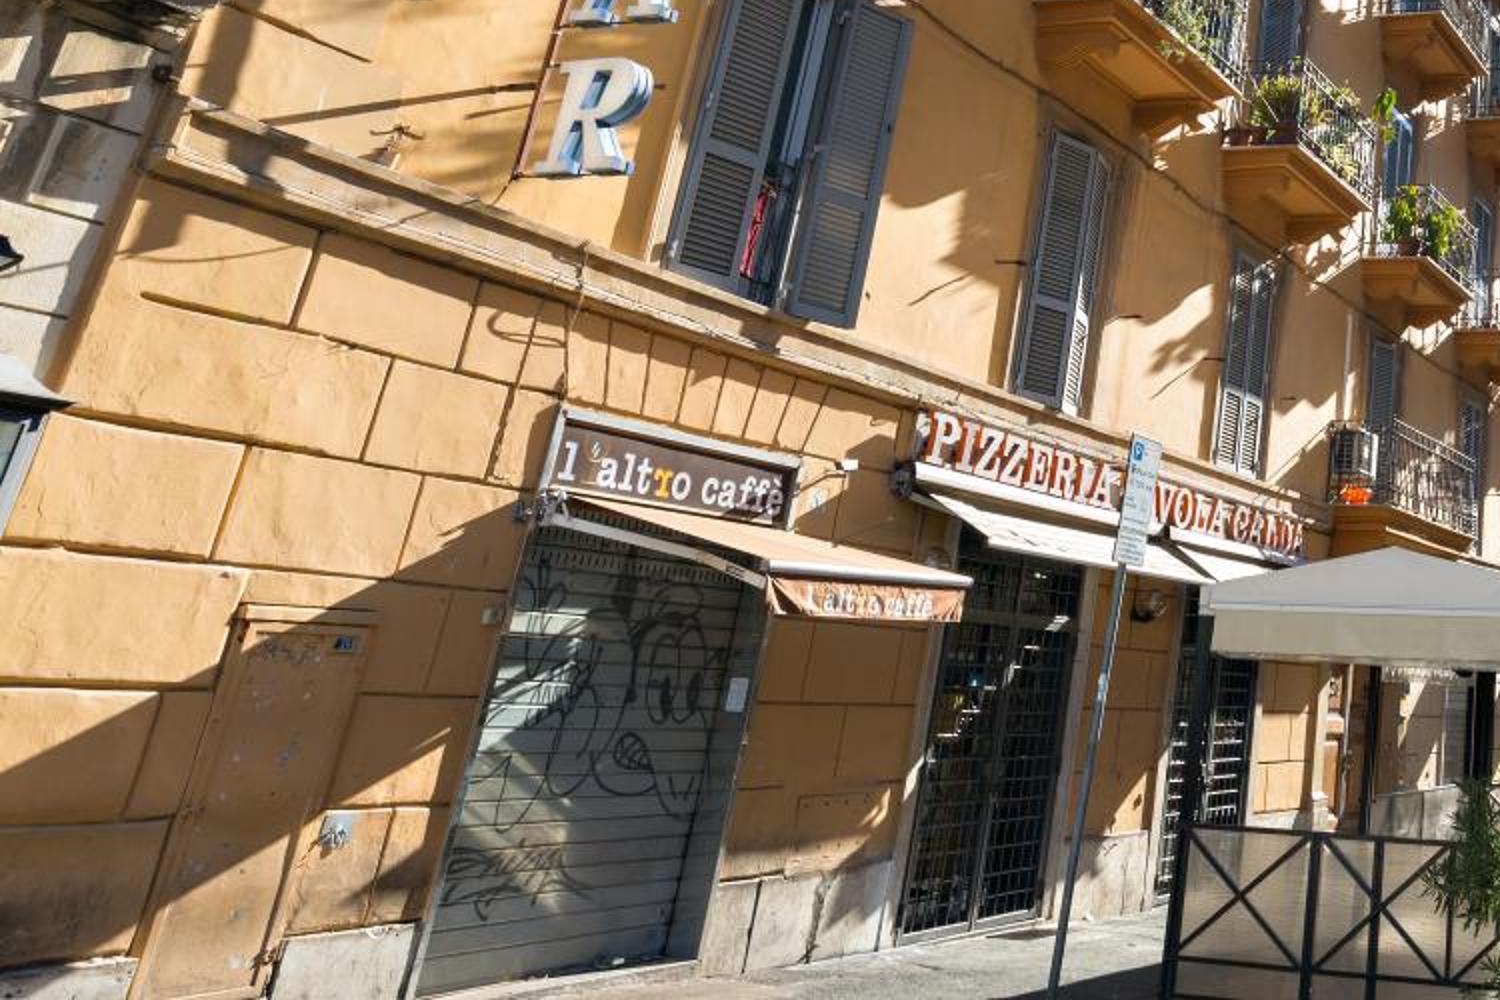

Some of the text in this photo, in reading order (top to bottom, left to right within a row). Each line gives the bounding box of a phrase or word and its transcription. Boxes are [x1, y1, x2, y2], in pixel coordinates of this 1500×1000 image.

[702, 475, 784, 516] caffè
[925, 411, 1119, 511] PIZZERIA
[1152, 481, 1226, 540] VOLA
